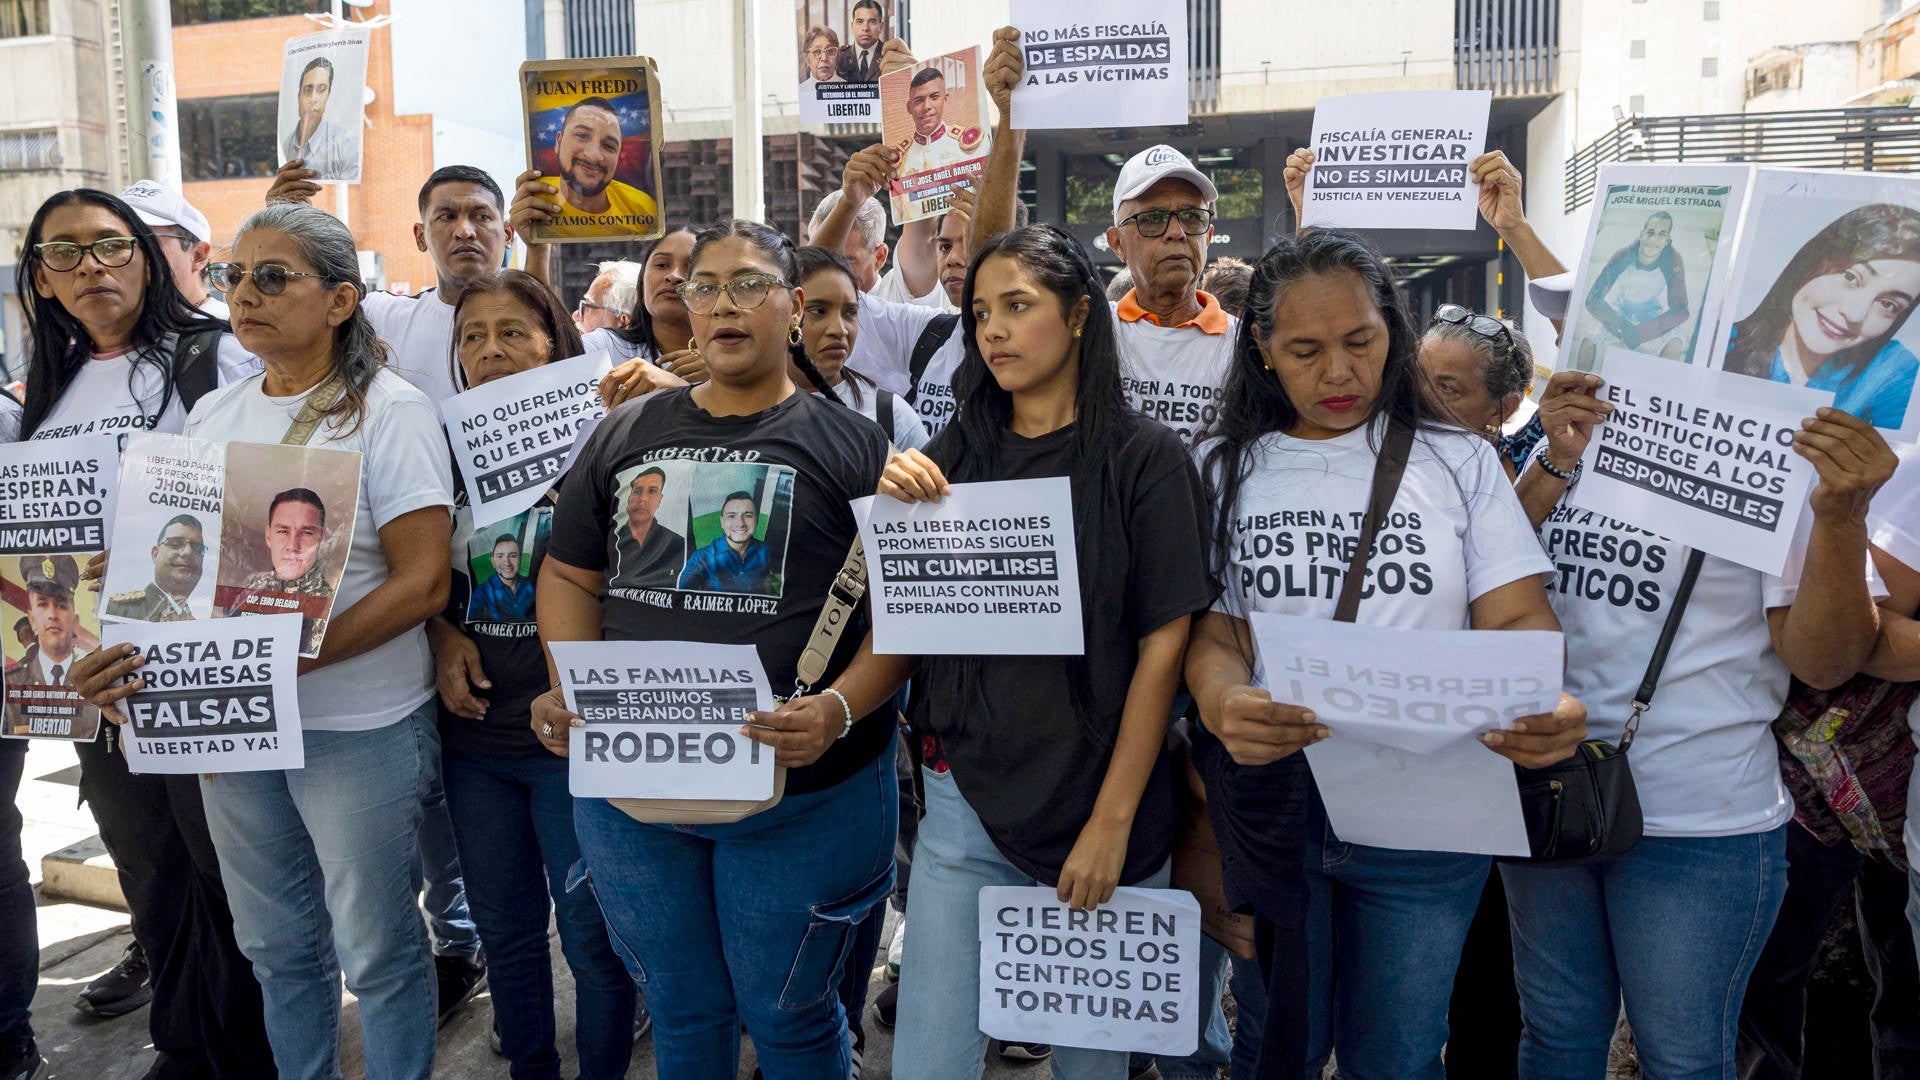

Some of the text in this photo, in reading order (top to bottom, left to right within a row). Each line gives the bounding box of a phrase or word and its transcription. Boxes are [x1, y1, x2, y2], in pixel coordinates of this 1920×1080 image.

[1025, 21, 1167, 43] NO MÁS FISCALÍA
[1029, 43, 1168, 65] DE ESPALDAS
[1027, 67, 1168, 85] A LAS VÍCTIMAS
[536, 79, 638, 95] JUAN FREDD
[828, 104, 870, 116] LIBERTAD
[1320, 128, 1473, 143] FISCALÍA GENERAL:
[1317, 144, 1467, 162] INVESTIGAR
[918, 176, 932, 185] JOSE
[934, 170, 952, 181] ANGEL
[953, 162, 981, 176] BARRENO
[1316, 169, 1464, 184] NO ES SIMULAR
[1312, 192, 1462, 201] JUSTICIA EN VENEZUELA
[1632, 186, 1676, 194] LIBERTAD
[1674, 198, 1721, 208] ESTRADA
[598, 215, 654, 225] CONTIGO
[1164, 383, 1174, 396] A
[462, 378, 599, 433] NO QUEREMOS
[467, 396, 602, 450] MÁS PROMESAS
[1608, 385, 1795, 447] EL SILENCIO
[84, 421, 94, 433] A
[1606, 408, 1791, 473] INSTITUCIONAL
[24, 459, 99, 477] FAMILIAS
[147, 456, 189, 468] LIBERTAD
[1602, 426, 1786, 494] PROTEGE A LOS
[146, 466, 163, 475] LOS
[165, 469, 199, 480] PRESOS
[1598, 452, 1777, 524] RESPONSABLES
[0, 499, 102, 520] EL ESTADO
[1578, 511, 1594, 525] A
[873, 516, 1051, 534] LAS LIBERACIONES
[1237, 510, 1326, 534] LIBEREN
[1331, 514, 1344, 531] A
[1, 526, 100, 548] INCUMPLE
[878, 534, 1054, 550] PROMETIDAS SIGUEN
[1238, 532, 1294, 562] LOS
[1549, 528, 1667, 573] PRESOS
[883, 557, 1055, 576] SIN CUMPLIRSE
[1241, 557, 1434, 600] POLÍTCOS
[884, 584, 1059, 597] FAMILIAS CONTINUAN
[247, 595, 258, 604] CAP.
[274, 598, 299, 609] DELGADO
[683, 594, 778, 615] RAIMER LÓPEZ
[886, 602, 1061, 614] ESPERANDO LIBERTAD
[232, 637, 274, 660] DE
[569, 668, 754, 684] LAS FAMILIAS
[616, 691, 713, 705] SEGUIMOS
[133, 696, 271, 728] FALSAS
[584, 707, 695, 720] ESPERANDO
[701, 707, 725, 720] EN
[29, 718, 71, 735] LIBERTAD
[138, 737, 278, 754] LIBERTAD YA!
[585, 731, 736, 764] RODEO
[996, 906, 1175, 937] CIERREN
[996, 932, 1180, 964] TODOS LOS
[995, 961, 1181, 992] CENTROS DE
[995, 988, 1179, 1023] TORTURAS
